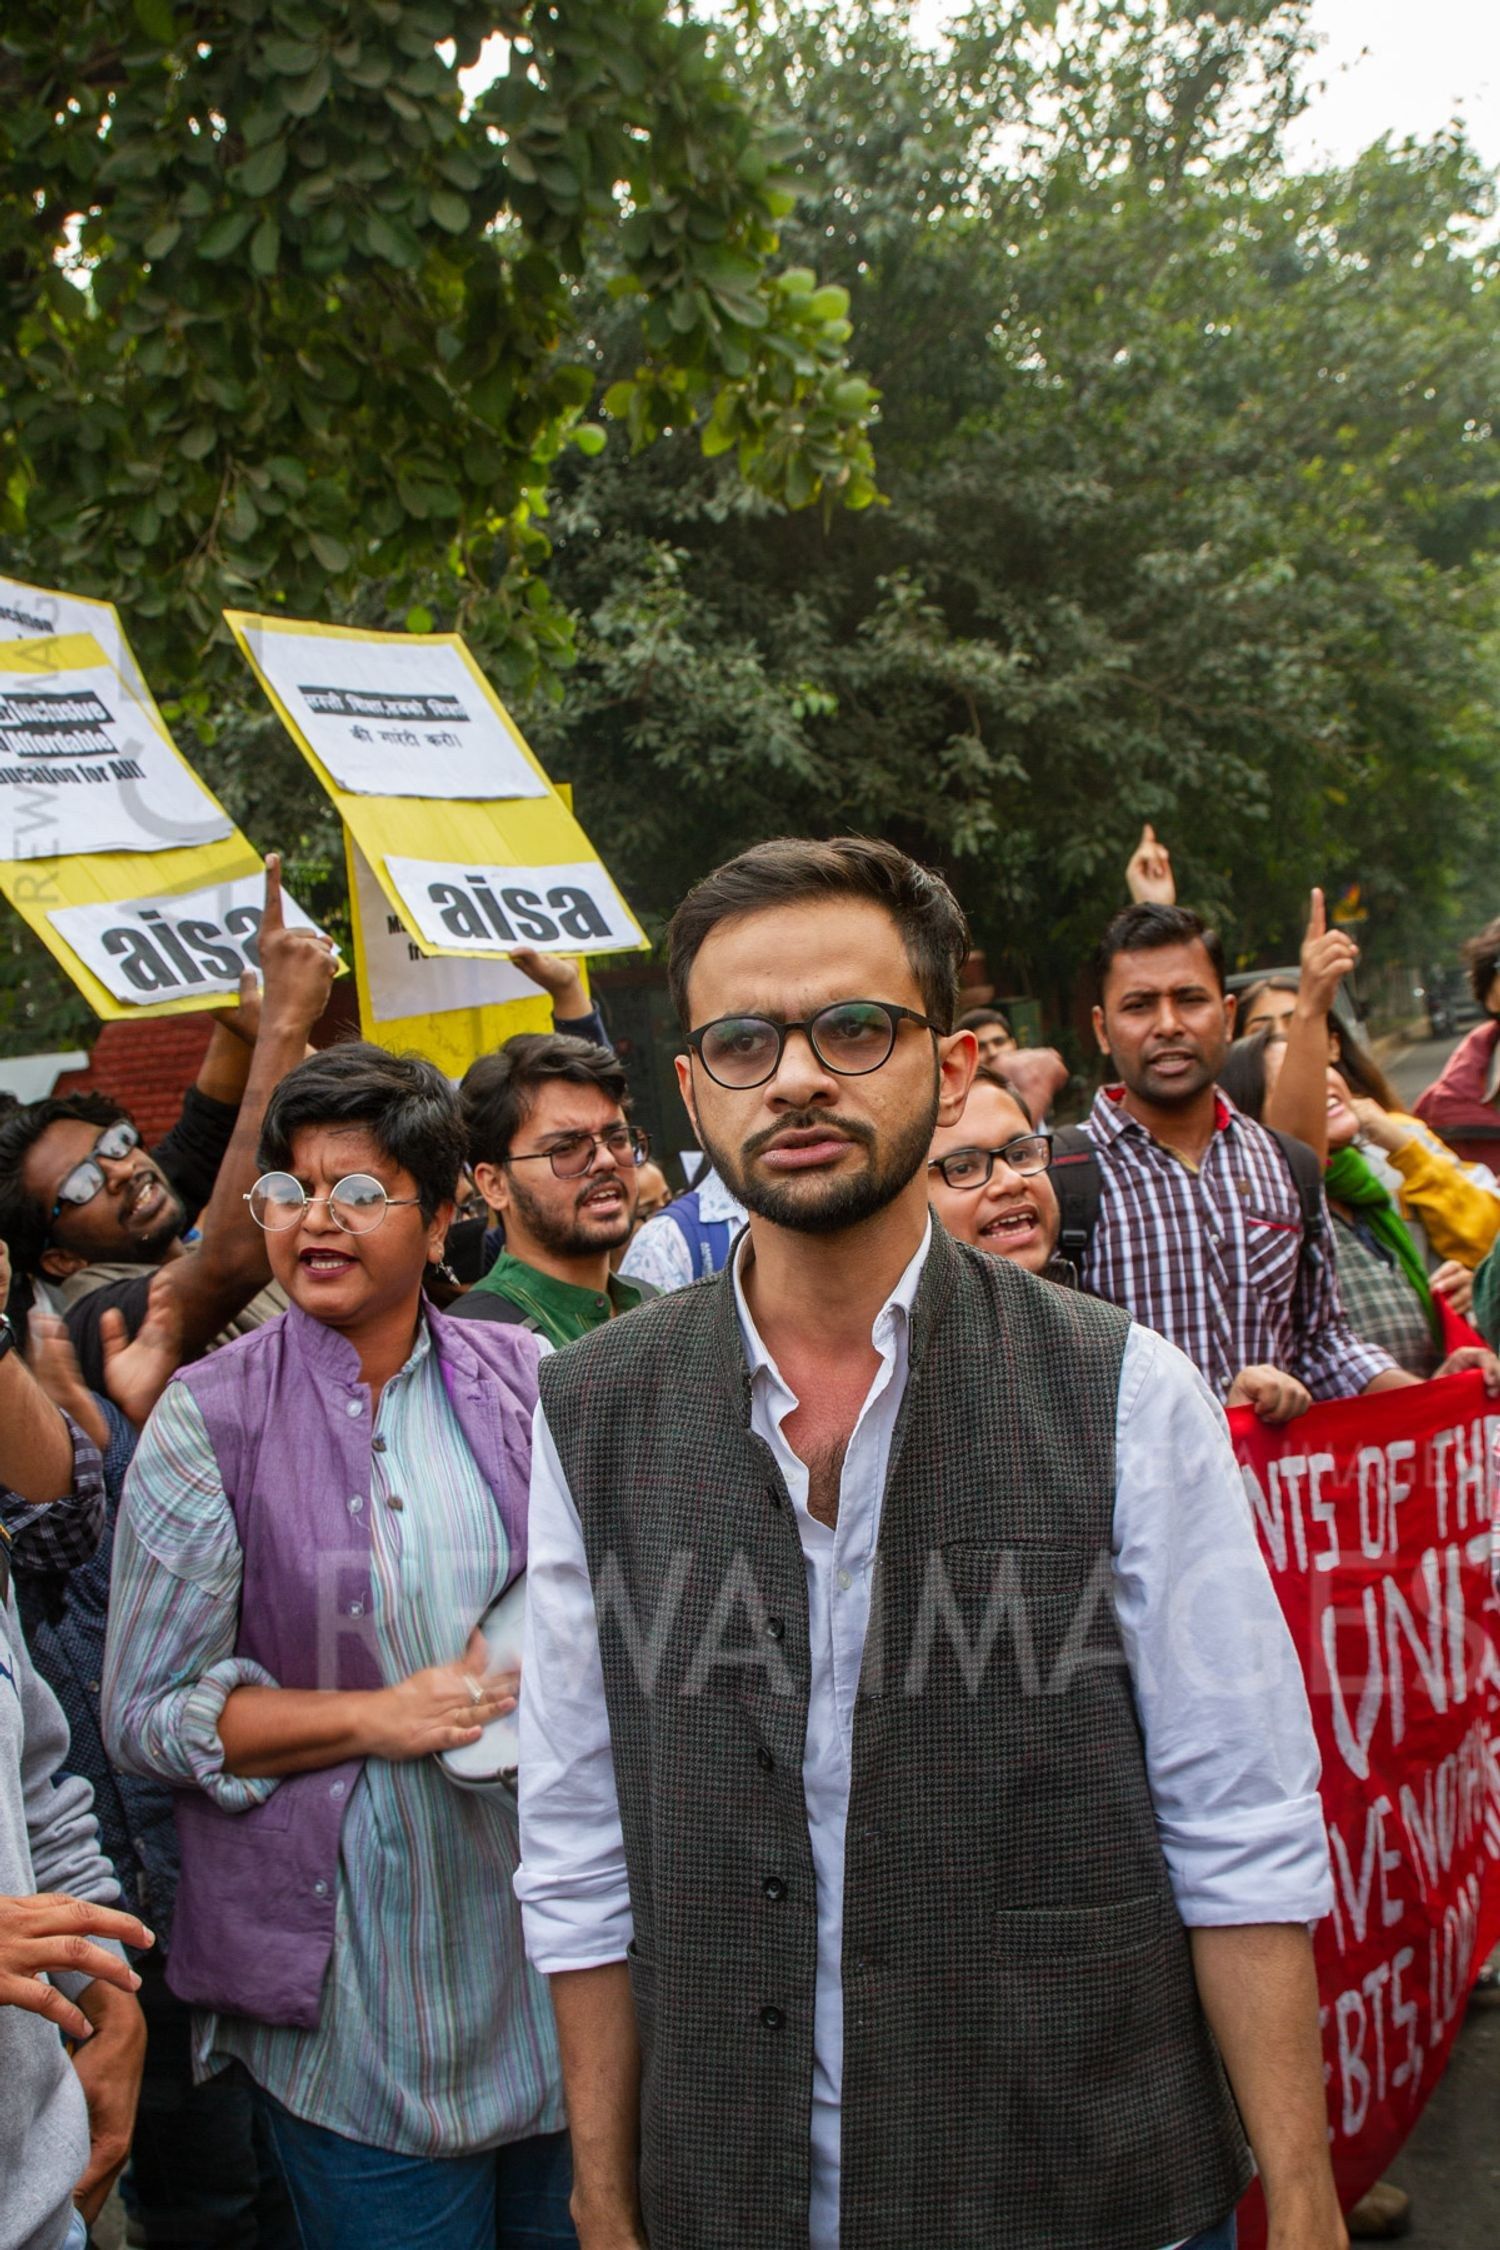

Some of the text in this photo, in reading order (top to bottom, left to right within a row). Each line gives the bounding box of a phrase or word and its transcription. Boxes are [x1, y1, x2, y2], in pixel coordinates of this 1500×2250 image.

[5, 730, 114, 755] Affordable
[8, 699, 108, 723] Inclusive
[76, 763, 111, 784] for
[428, 874, 613, 942] aisa
[1358, 1440, 1416, 1560] OF
[1312, 1794, 1405, 1957] VE
[1319, 1945, 1424, 2144] BTS,
